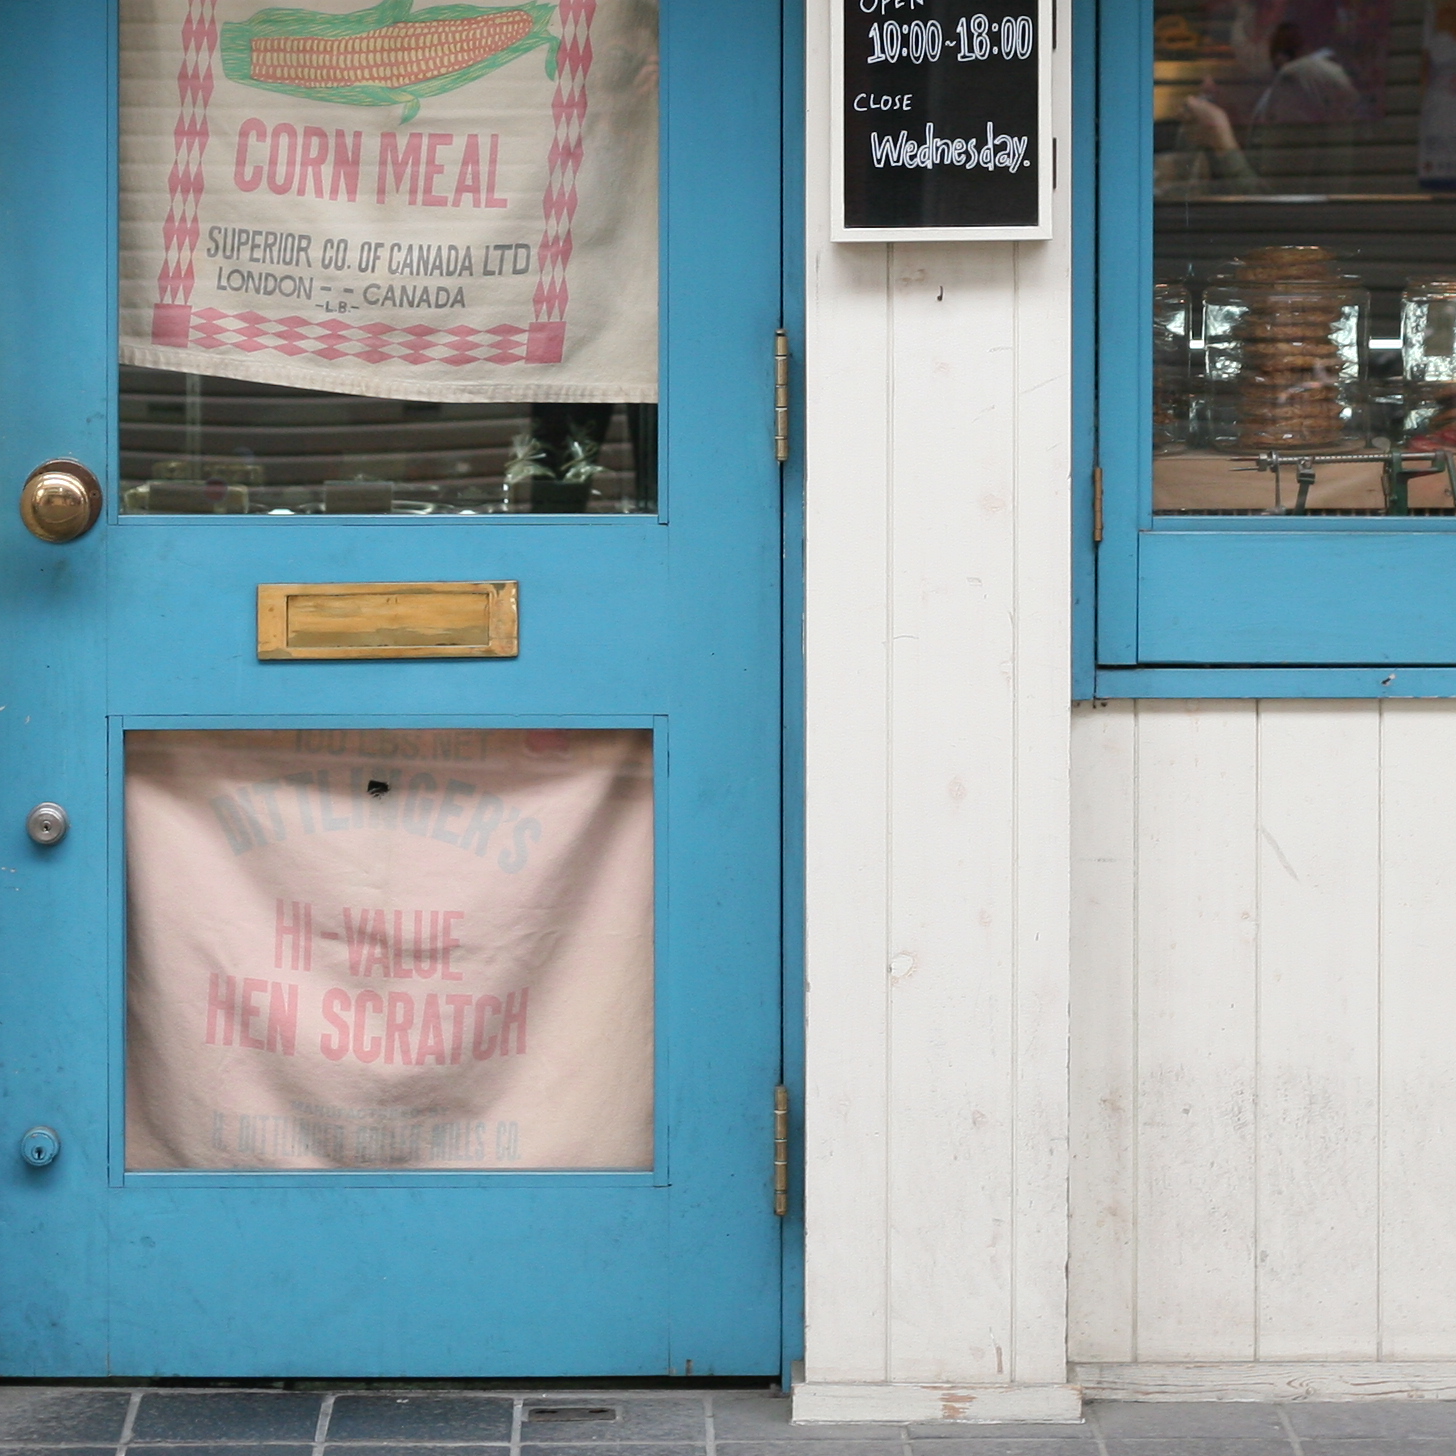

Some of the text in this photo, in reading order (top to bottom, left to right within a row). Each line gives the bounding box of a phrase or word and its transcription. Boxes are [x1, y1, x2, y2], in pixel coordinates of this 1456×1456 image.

[853, 93, 913, 112] CLOSE
[233, 117, 508, 209] CORN MEAL
[206, 225, 532, 278] SUPERIOR CO. OF CANADA LTD
[216, 267, 314, 301] LONDON
[363, 283, 466, 310] CANADA
[208, 766, 542, 875] DITTLINGER'S
[205, 972, 531, 1066] HEN SCRATCH
